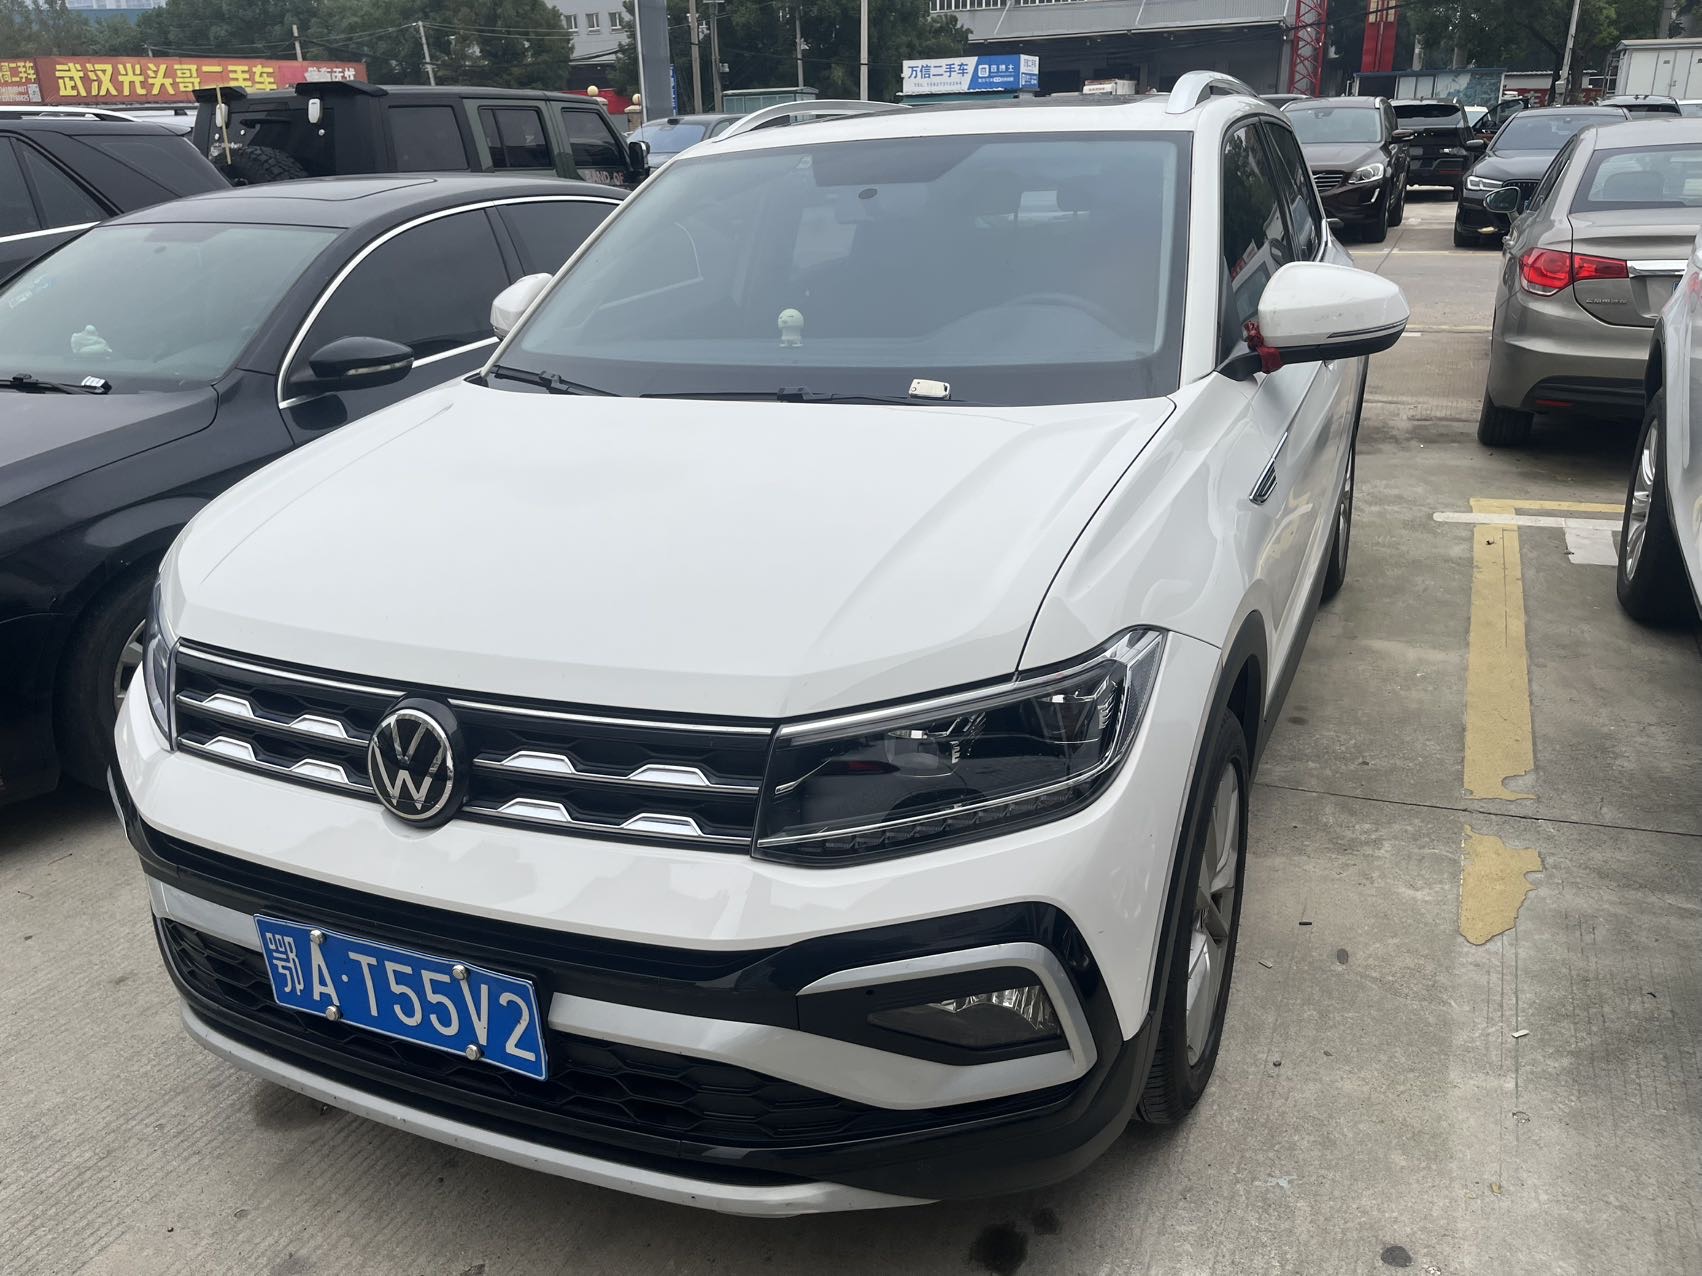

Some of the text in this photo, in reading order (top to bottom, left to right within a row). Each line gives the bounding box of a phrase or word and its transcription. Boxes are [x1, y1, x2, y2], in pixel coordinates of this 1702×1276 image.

[55, 62, 277, 97] 武汉光头哥二手车
[907, 62, 969, 79] 万信二手车
